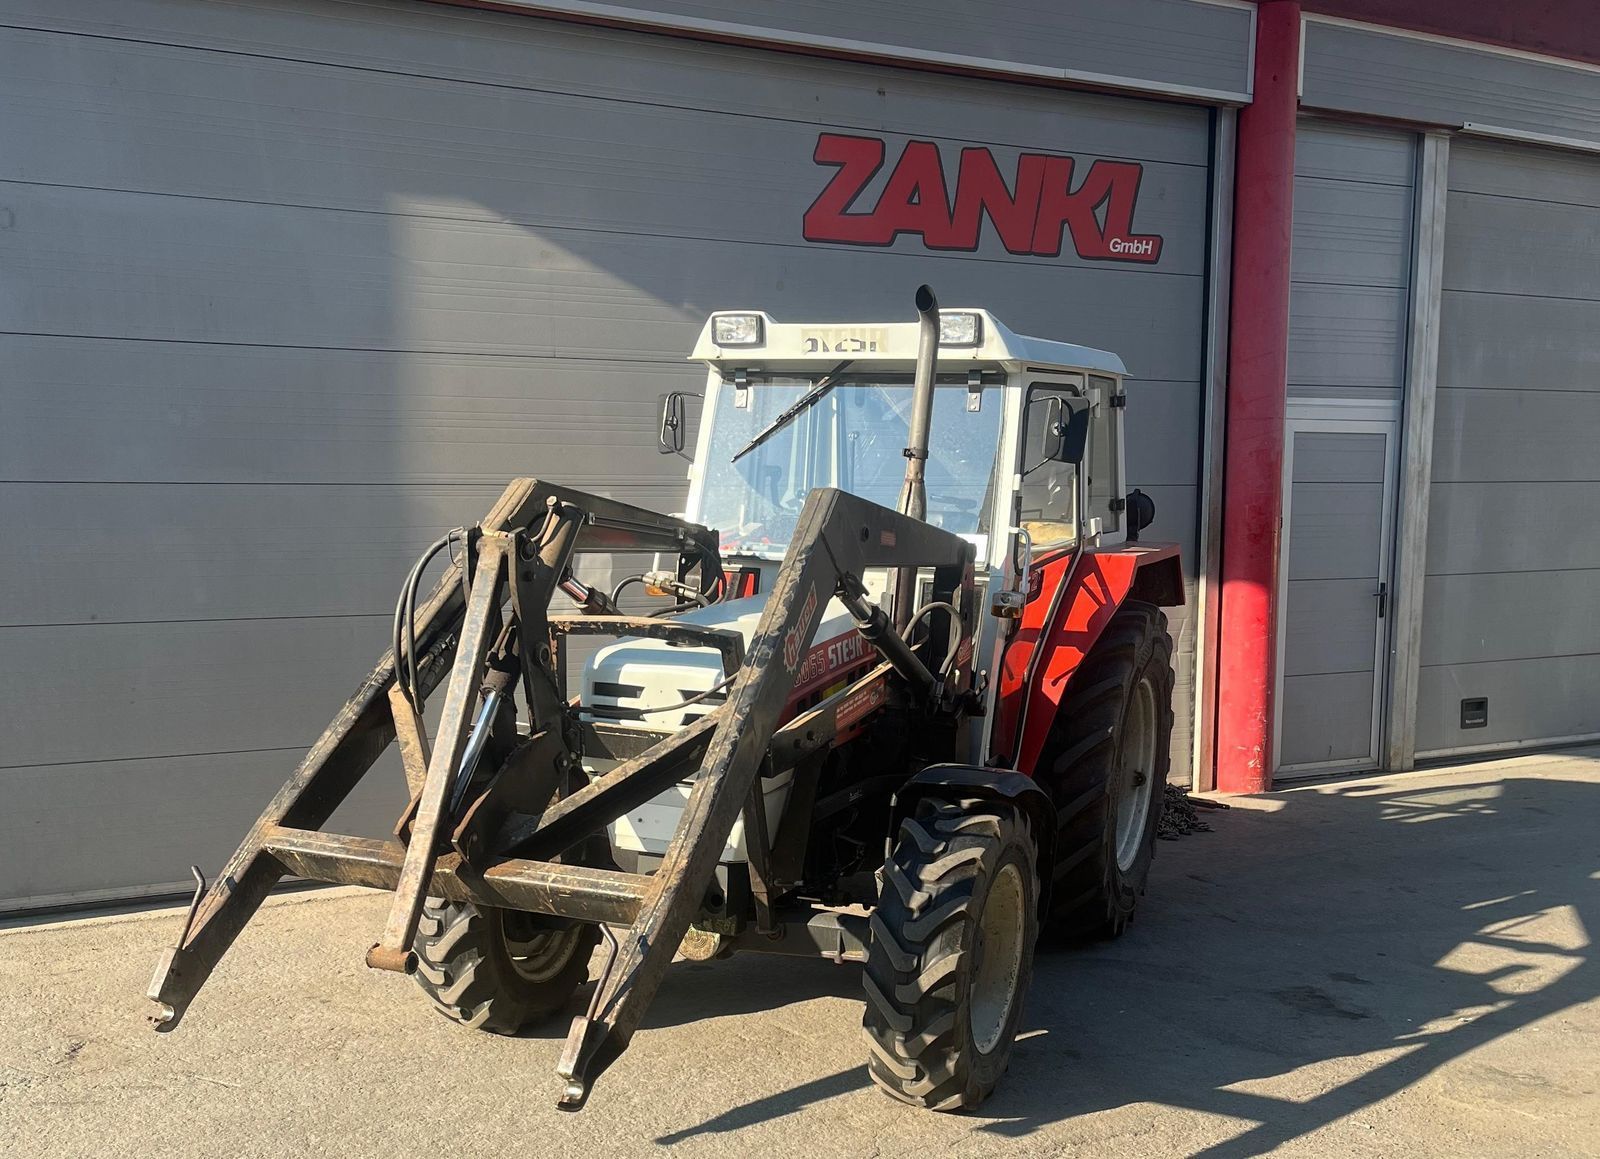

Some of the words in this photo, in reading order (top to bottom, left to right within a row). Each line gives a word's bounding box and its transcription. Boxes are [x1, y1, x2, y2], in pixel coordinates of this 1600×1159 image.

[803, 132, 1163, 262] ZANKL
[1108, 238, 1154, 255] GmbH
[827, 635, 864, 670] STEYR
